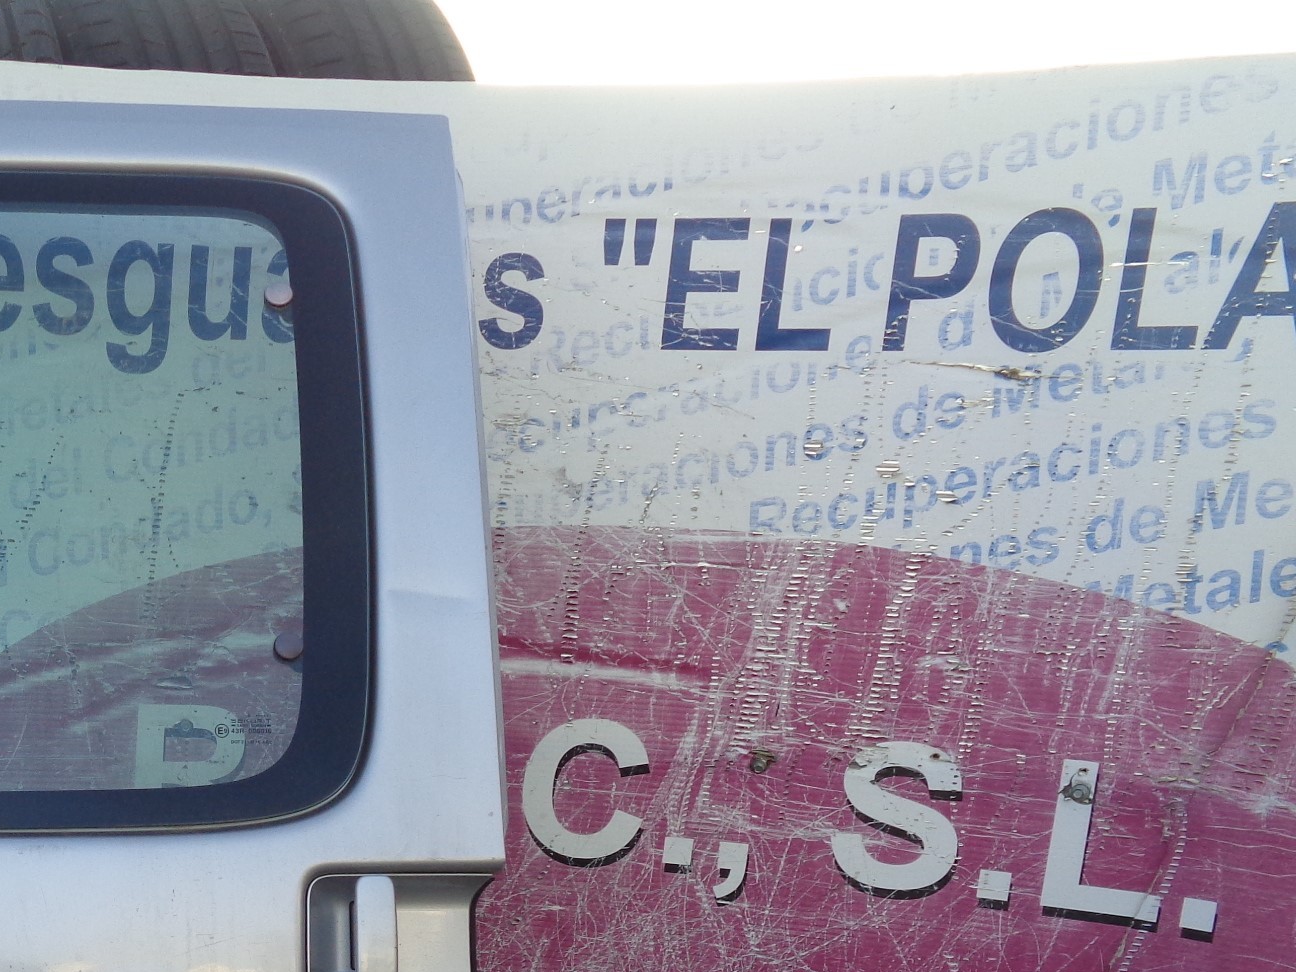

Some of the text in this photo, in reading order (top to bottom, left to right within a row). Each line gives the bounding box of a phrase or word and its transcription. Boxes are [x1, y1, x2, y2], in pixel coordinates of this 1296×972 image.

[602, 216, 833, 353] "EL
[1084, 499, 1167, 556] de
[830, 740, 1220, 943] S.L.
